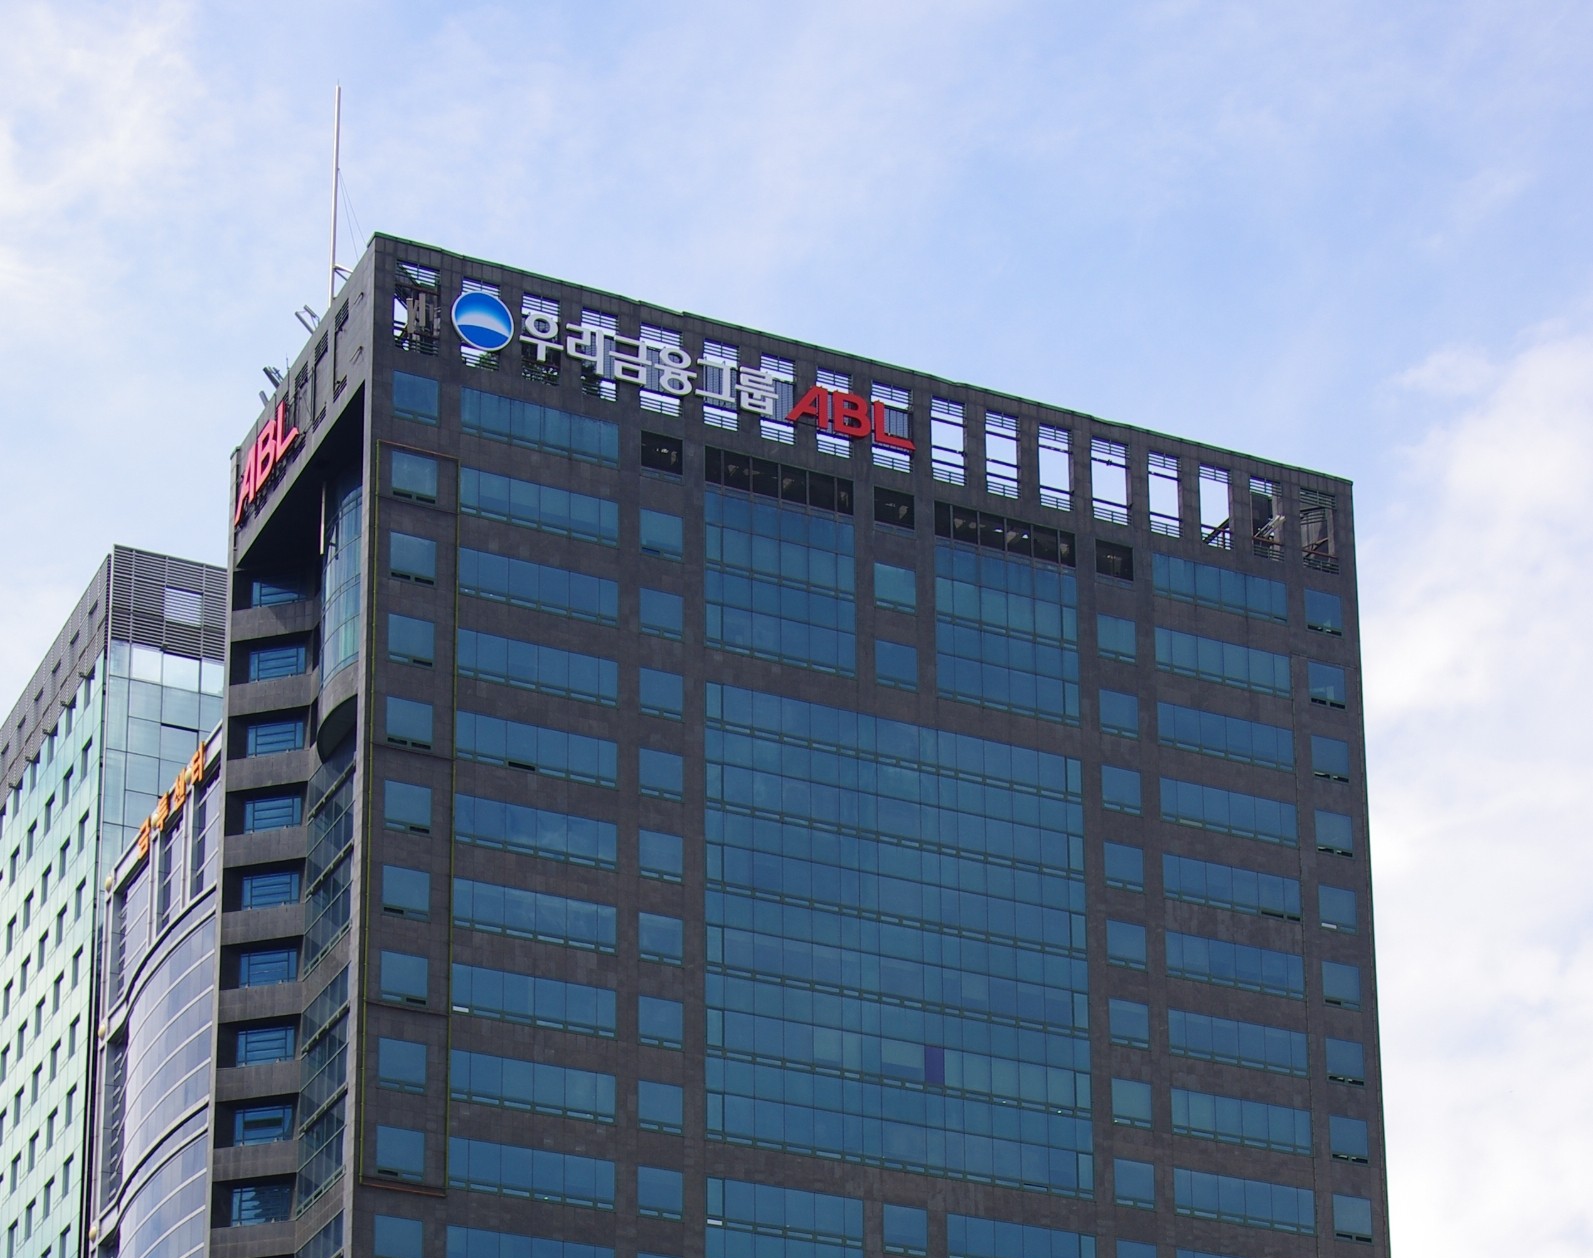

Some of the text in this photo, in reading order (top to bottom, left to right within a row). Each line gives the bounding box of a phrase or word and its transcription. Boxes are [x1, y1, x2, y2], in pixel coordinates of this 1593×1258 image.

[519, 312, 916, 451] 우리금융그룹 ABL
[234, 400, 299, 527] ABL
[138, 741, 205, 859] 금투센터
